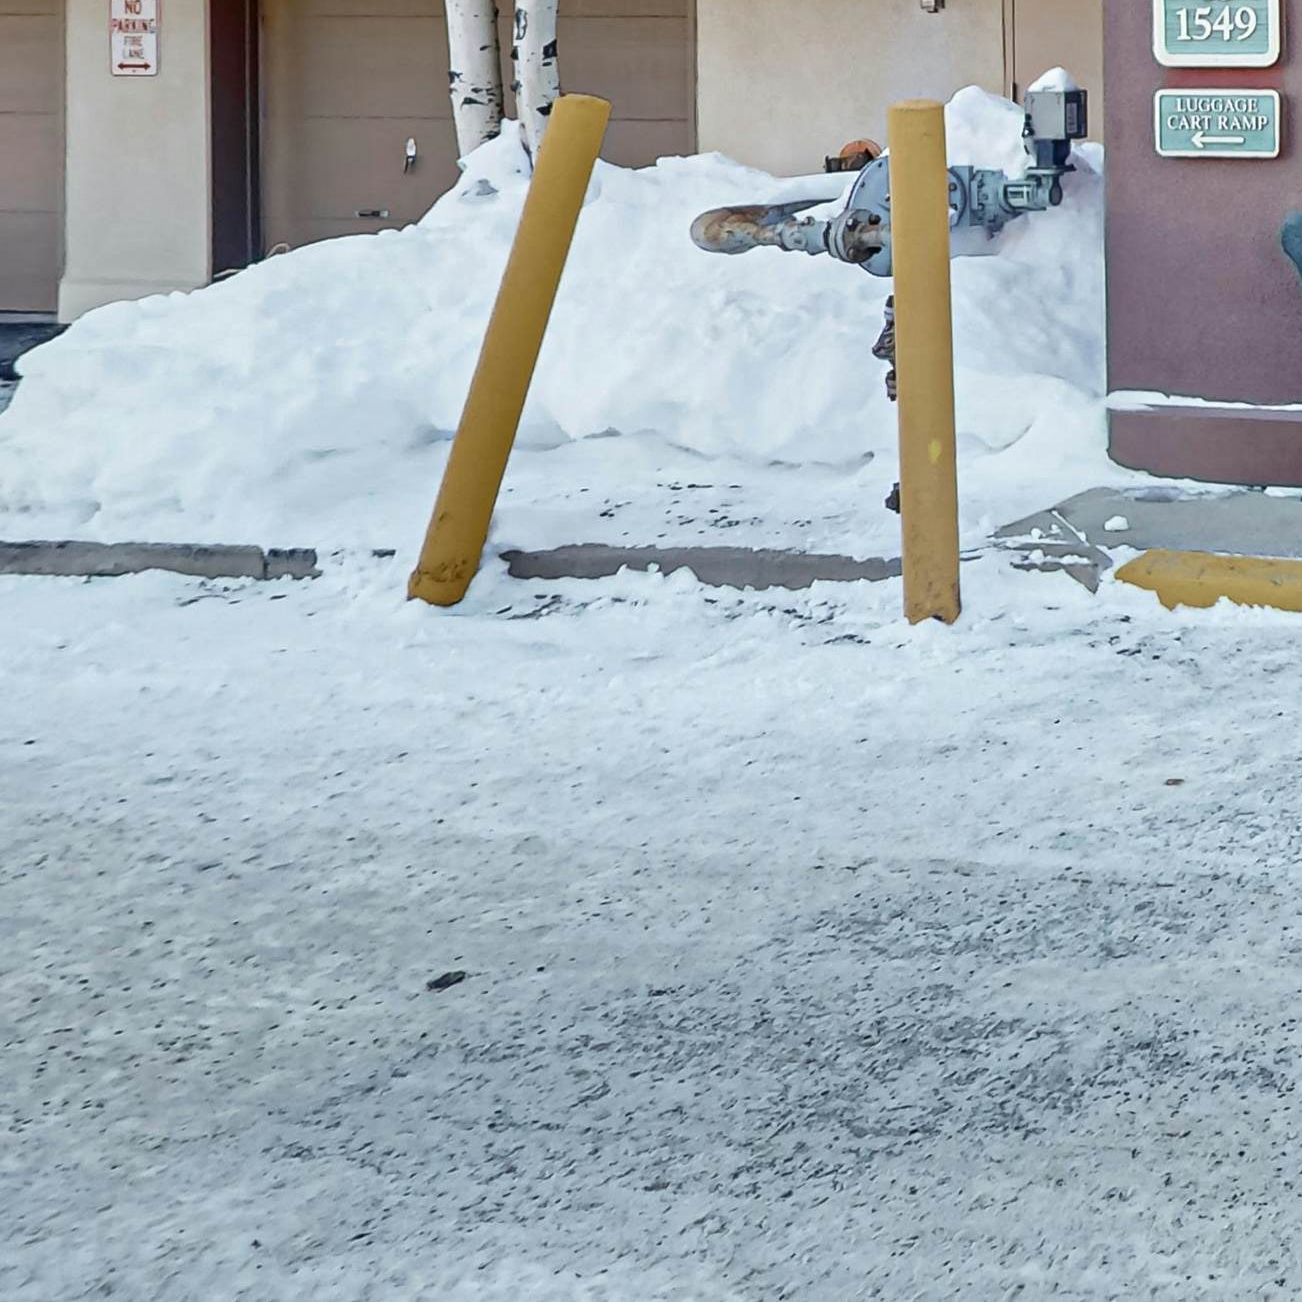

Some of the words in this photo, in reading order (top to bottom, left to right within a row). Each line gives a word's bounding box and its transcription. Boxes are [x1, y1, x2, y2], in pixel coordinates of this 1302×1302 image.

[124, 0, 142, 14] NO
[1175, 6, 1257, 41] 1549
[1176, 98, 1259, 113] LUGGAGE
[1167, 114, 1212, 131] CART
[1217, 114, 1269, 131] RAMP
